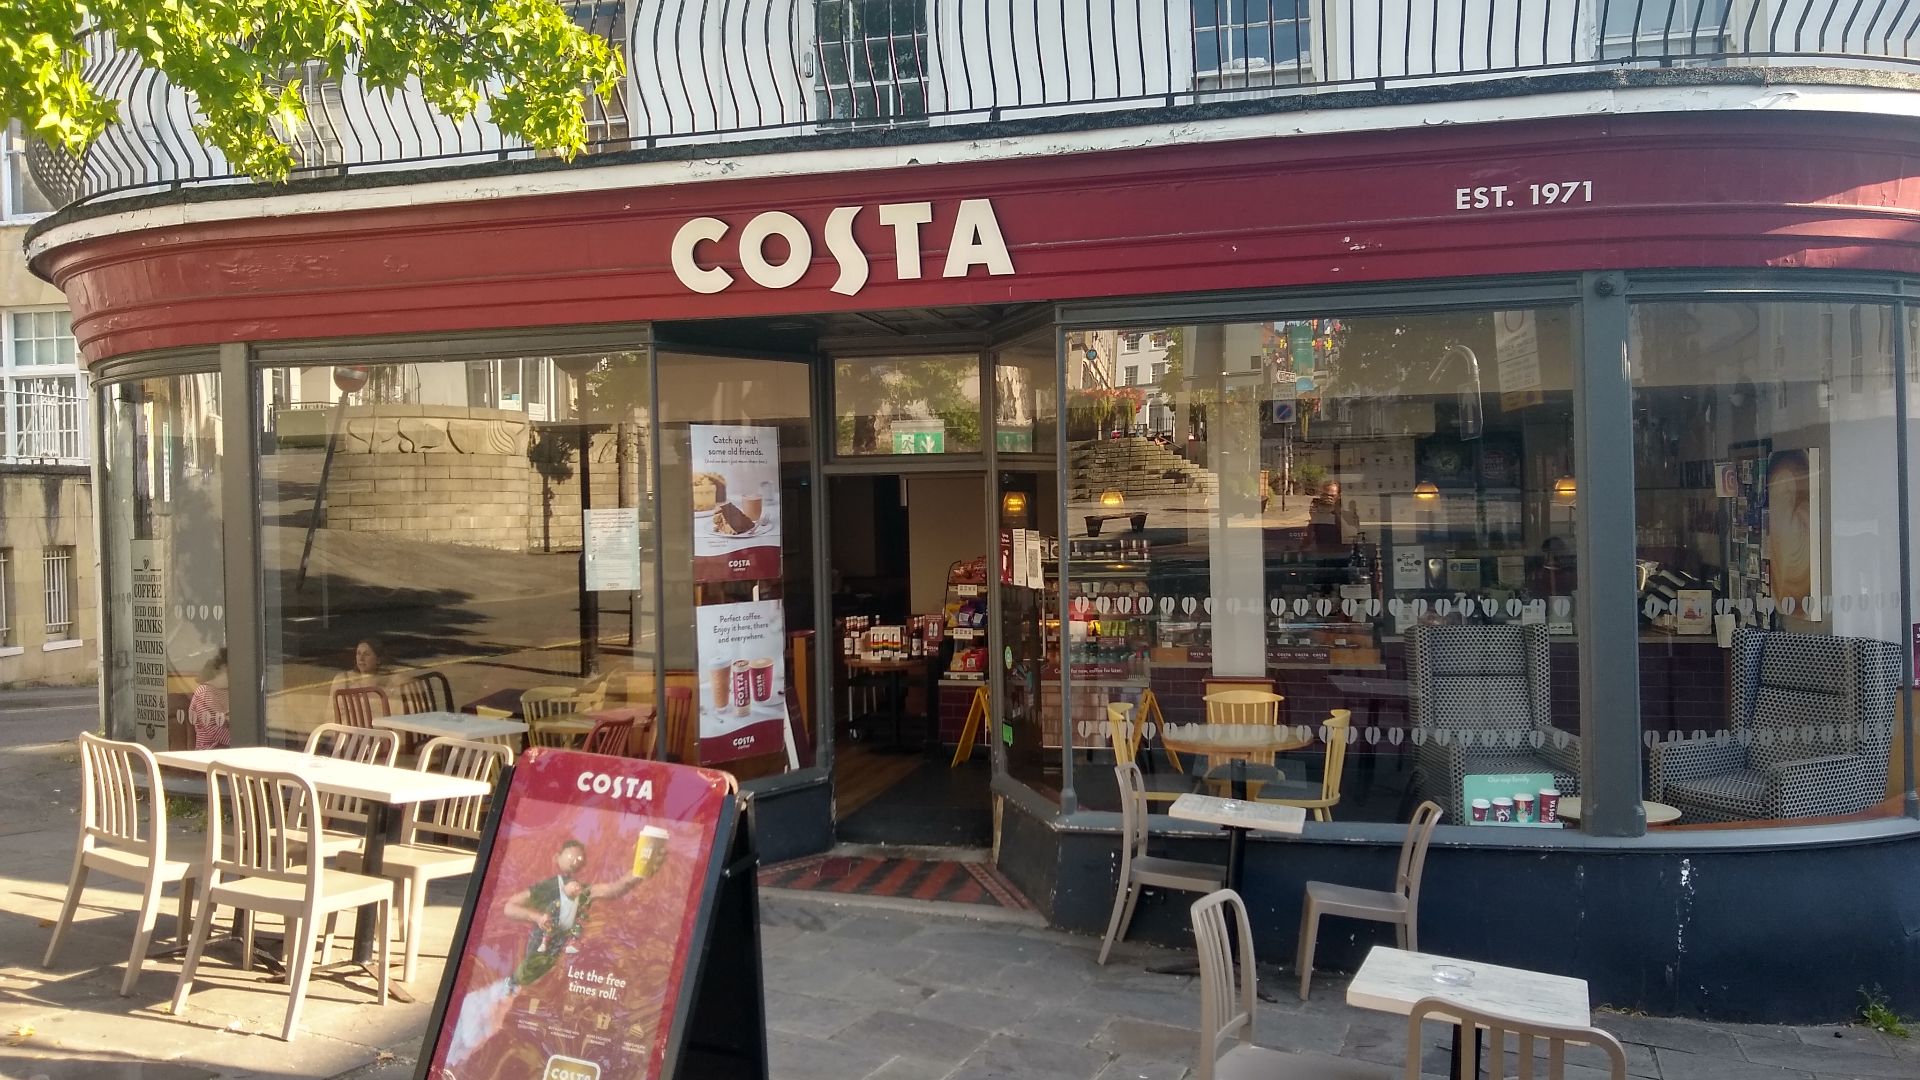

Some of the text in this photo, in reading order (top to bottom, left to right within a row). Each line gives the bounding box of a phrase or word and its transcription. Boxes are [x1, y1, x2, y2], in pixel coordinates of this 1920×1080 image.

[1456, 180, 1593, 210] EST. 1971
[671, 198, 1016, 297] COSTA
[712, 435, 759, 447] Catch up with
[727, 447, 738, 456] old
[739, 447, 764, 456] friends.
[728, 559, 751, 568] COSTA
[133, 583, 162, 599] COFFEE
[134, 604, 163, 618] ICED COLD
[719, 612, 763, 623] Perfect coffee.
[135, 618, 163, 634] DRINKS
[713, 625, 731, 635] Enjoy
[738, 623, 753, 631] here,
[718, 633, 766, 644] and everywhere.
[135, 639, 164, 655] PANINIS
[136, 661, 165, 676] TOASTED
[736, 673, 744, 706] COSTA
[136, 693, 166, 709] CAKES &
[136, 708, 166, 722] PASTRIES
[732, 736, 754, 746] COSTA
[577, 771, 653, 801] COSTA
[1548, 799, 1556, 821] COSTA
[567, 965, 626, 988] Let the free
[568, 981, 618, 1001] times roll.
